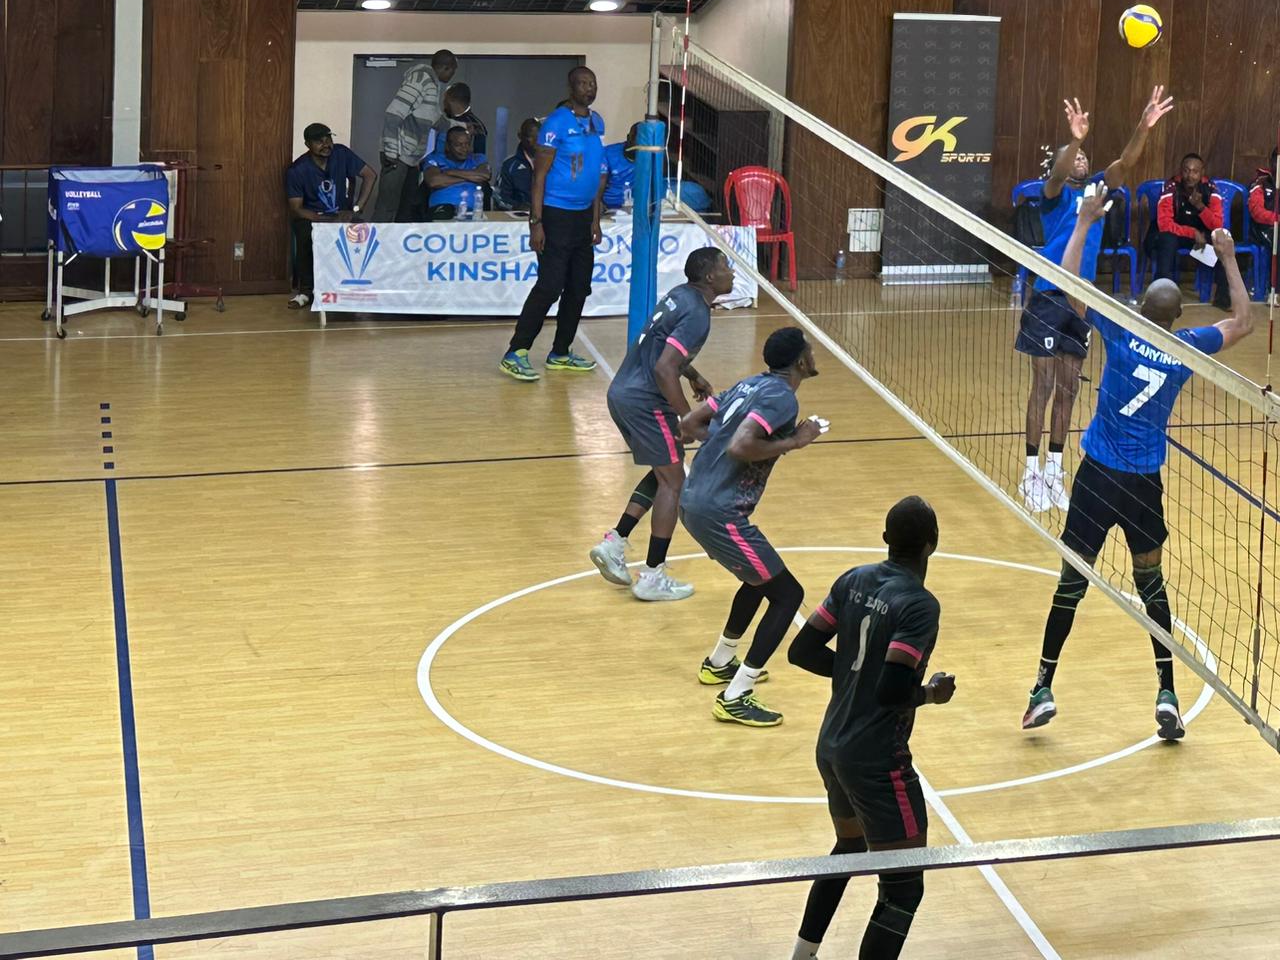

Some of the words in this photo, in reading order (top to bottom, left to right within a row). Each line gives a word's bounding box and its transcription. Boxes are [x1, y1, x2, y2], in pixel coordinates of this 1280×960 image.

[940, 152, 992, 163] SPORTS
[403, 234, 509, 253] COUPE
[427, 261, 539, 282] KINSHA
[321, 292, 337, 304] 21
[1118, 363, 1168, 417] 7
[850, 614, 871, 672] 1
